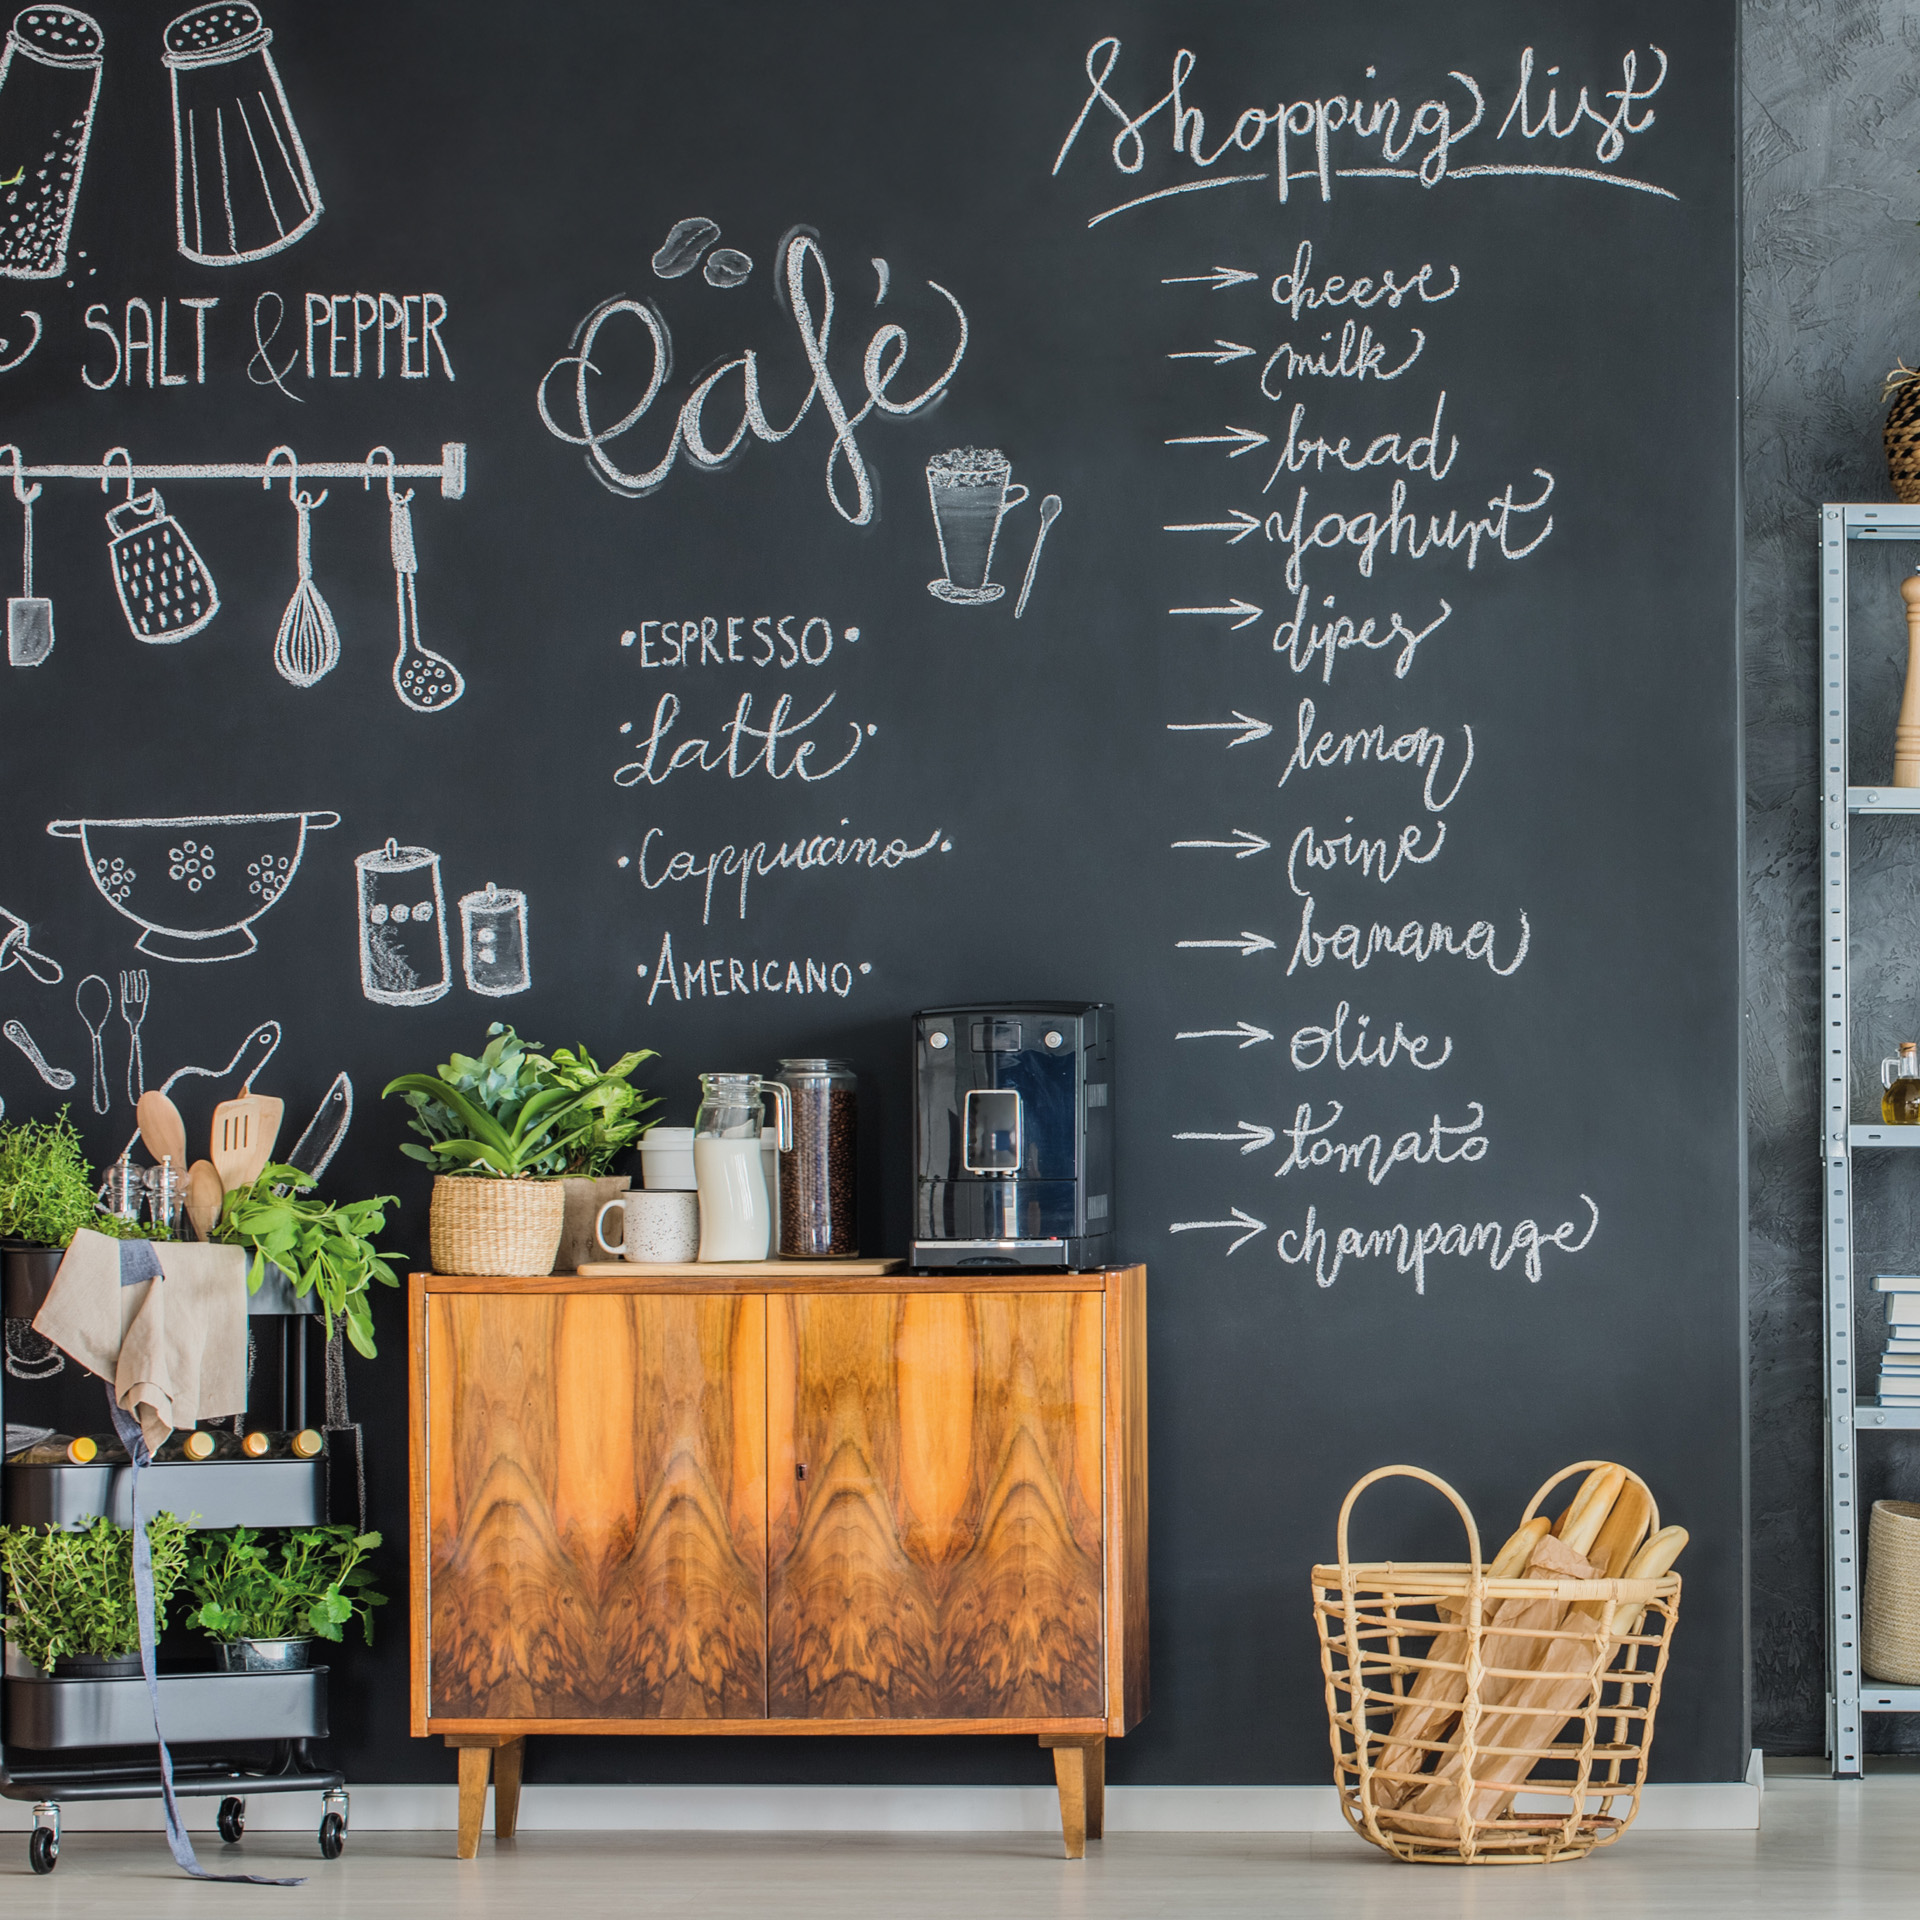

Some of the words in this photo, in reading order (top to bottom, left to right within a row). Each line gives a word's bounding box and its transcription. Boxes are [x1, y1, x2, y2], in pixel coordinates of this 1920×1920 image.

[1497, 44, 1667, 163] list
[1272, 240, 1460, 321] cheese
[82, 297, 219, 390] SALT
[247, 291, 305, 402] &
[305, 293, 455, 381] PEPPER
[537, 234, 968, 526] Café
[1261, 319, 1425, 401] milk
[1260, 391, 1459, 493] bread
[641, 616, 833, 669] ESPRESSO
[614, 690, 862, 787] Latte
[1278, 698, 1474, 812] lemon
[639, 818, 941, 925] Cappuccino
[1288, 816, 1446, 896] wine
[648, 932, 852, 1005] AMERICANO
[1287, 897, 1530, 976] banana
[1290, 1001, 1453, 1071] olive
[1274, 1100, 1489, 1185] tomato
[1278, 1194, 1599, 1295] champange
